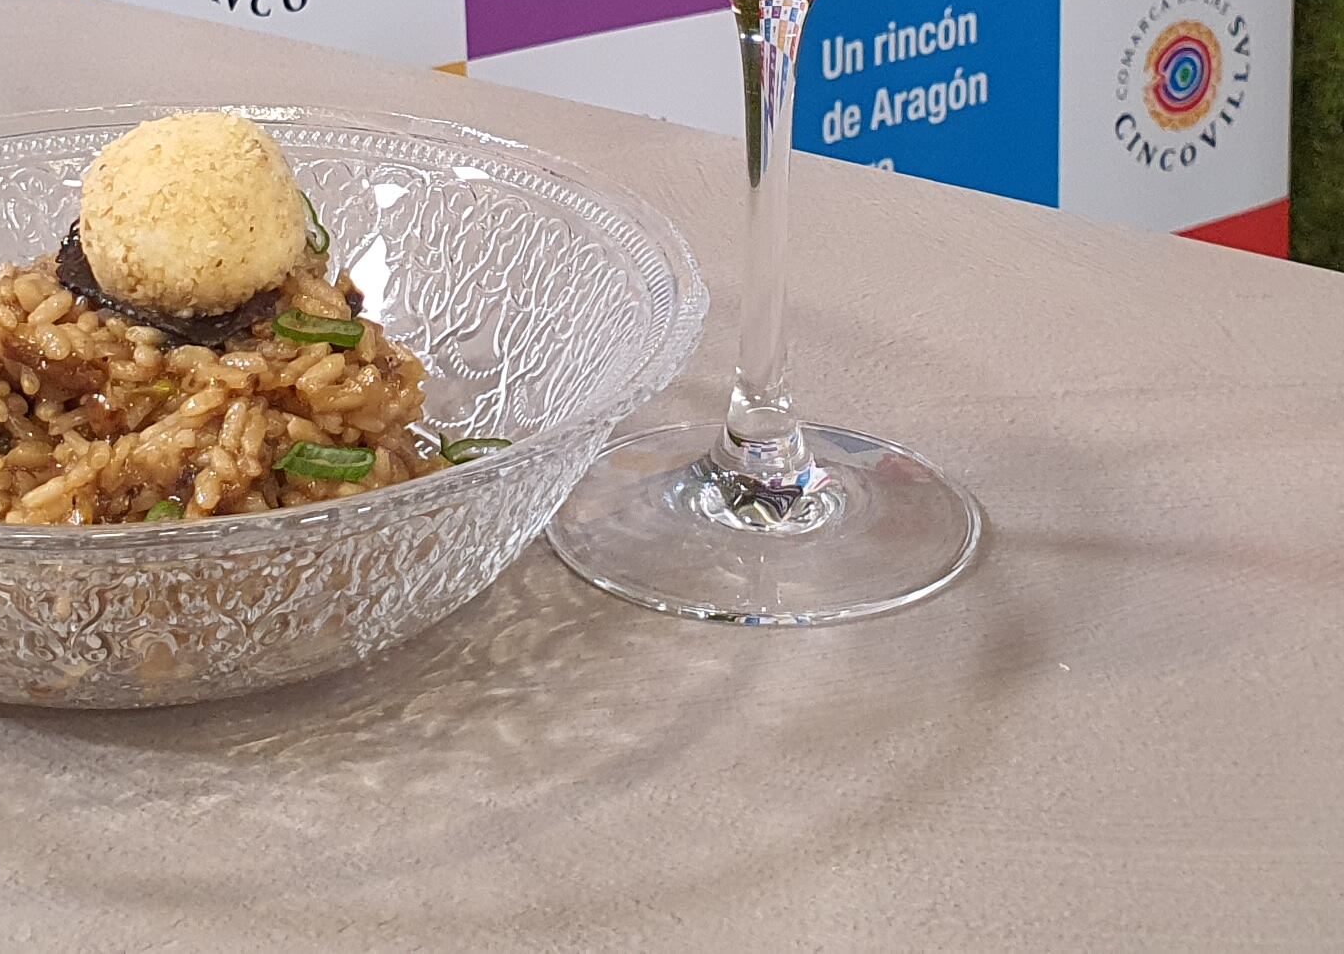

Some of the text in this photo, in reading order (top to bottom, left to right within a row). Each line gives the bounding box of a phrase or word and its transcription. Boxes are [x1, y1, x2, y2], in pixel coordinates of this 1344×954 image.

[822, 35, 864, 81] Un
[873, 5, 978, 66] rincón
[822, 67, 988, 145] de Aragón
